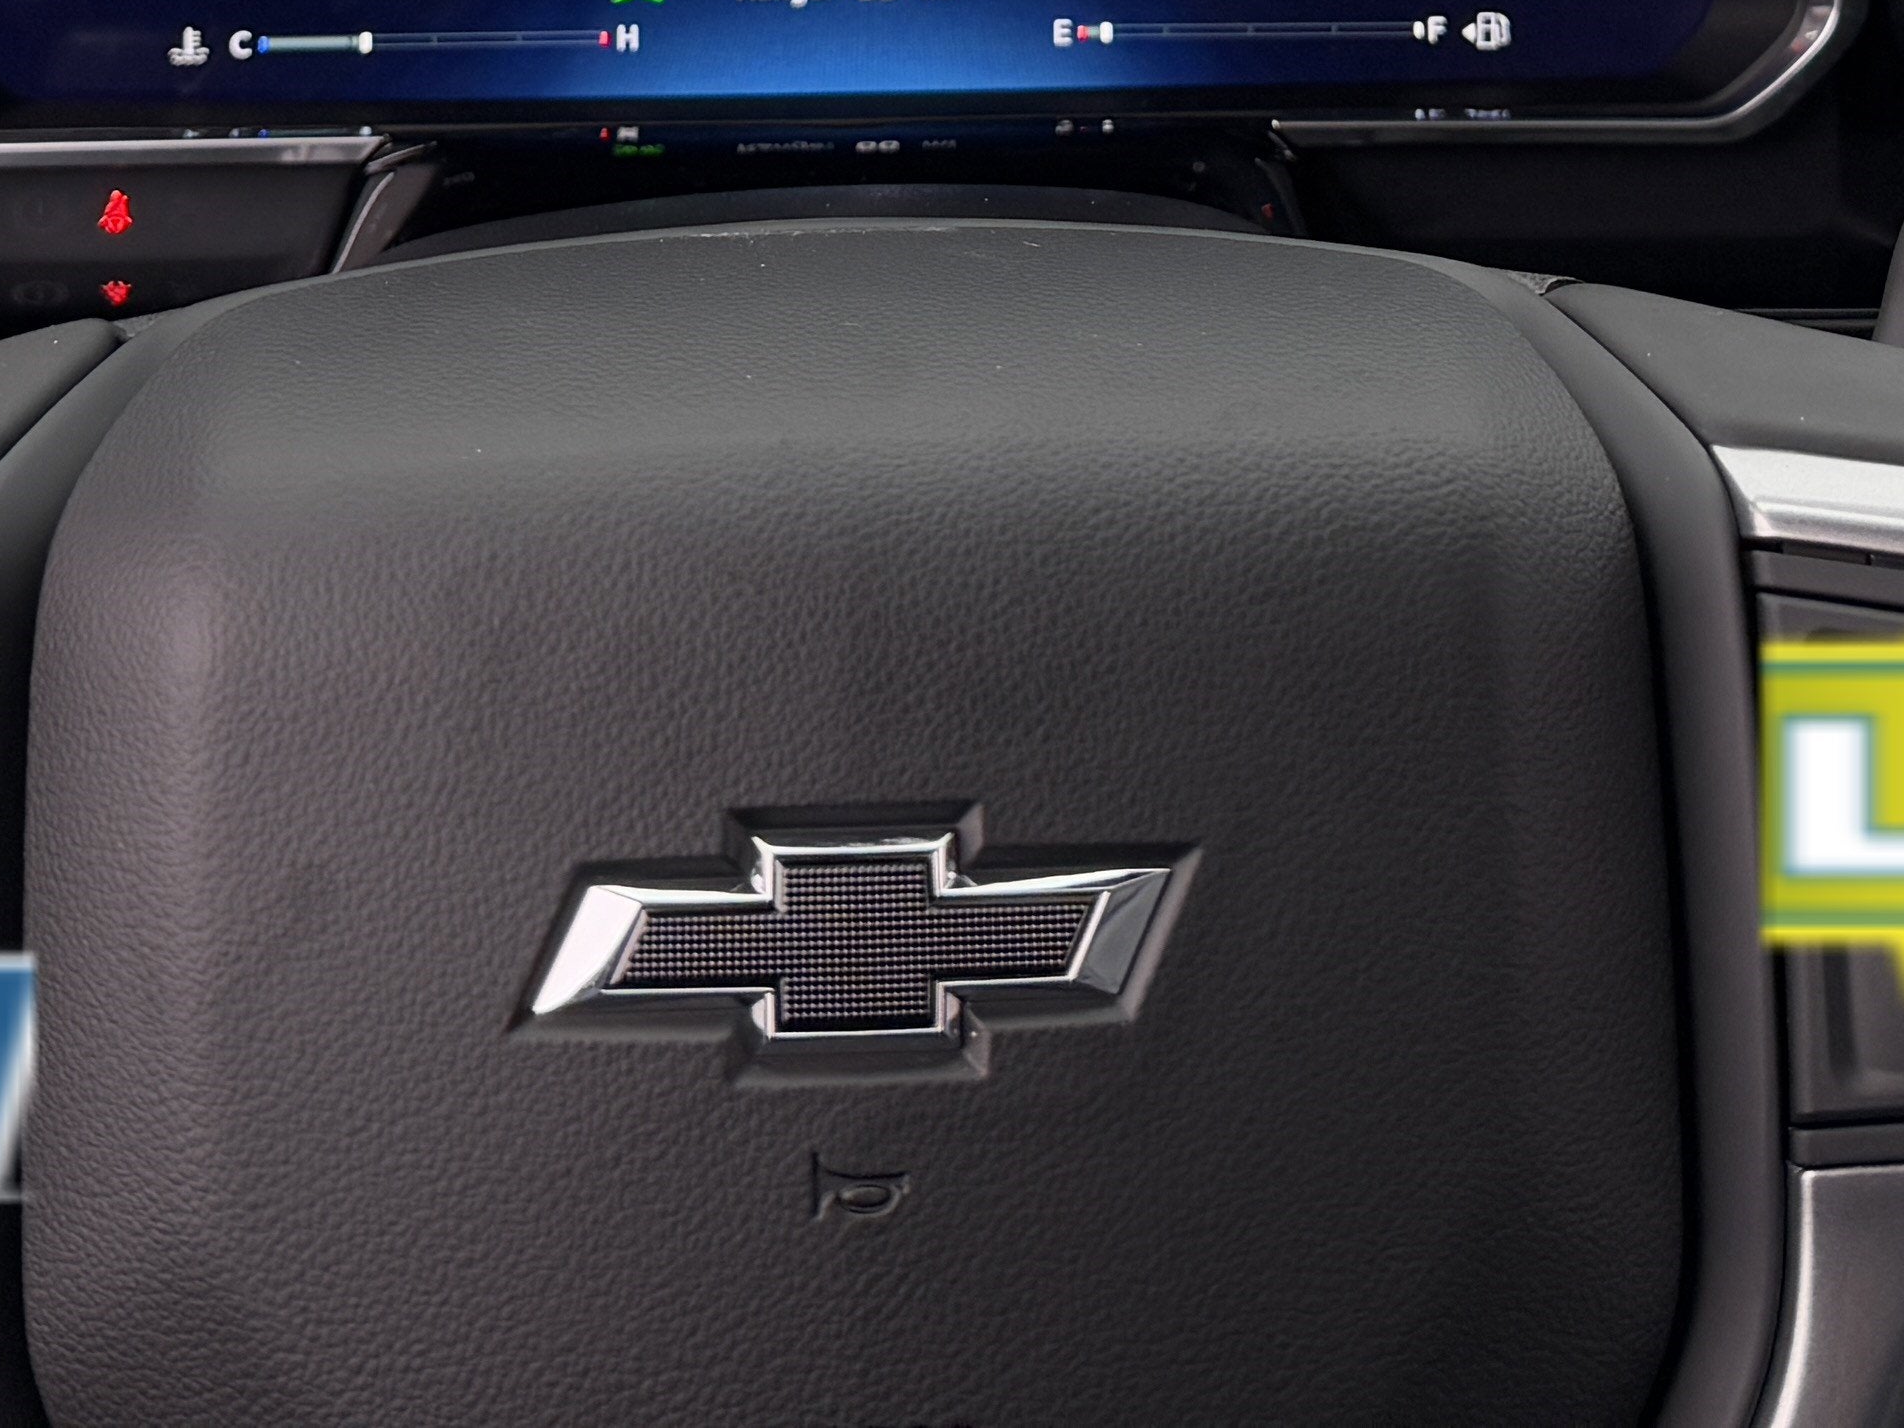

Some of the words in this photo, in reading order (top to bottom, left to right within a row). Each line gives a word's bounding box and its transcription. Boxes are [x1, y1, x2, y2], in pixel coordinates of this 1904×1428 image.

[615, 23, 639, 52] H
[1052, 17, 1074, 46] E
[1426, 15, 1448, 44] F
[227, 29, 253, 61] C
